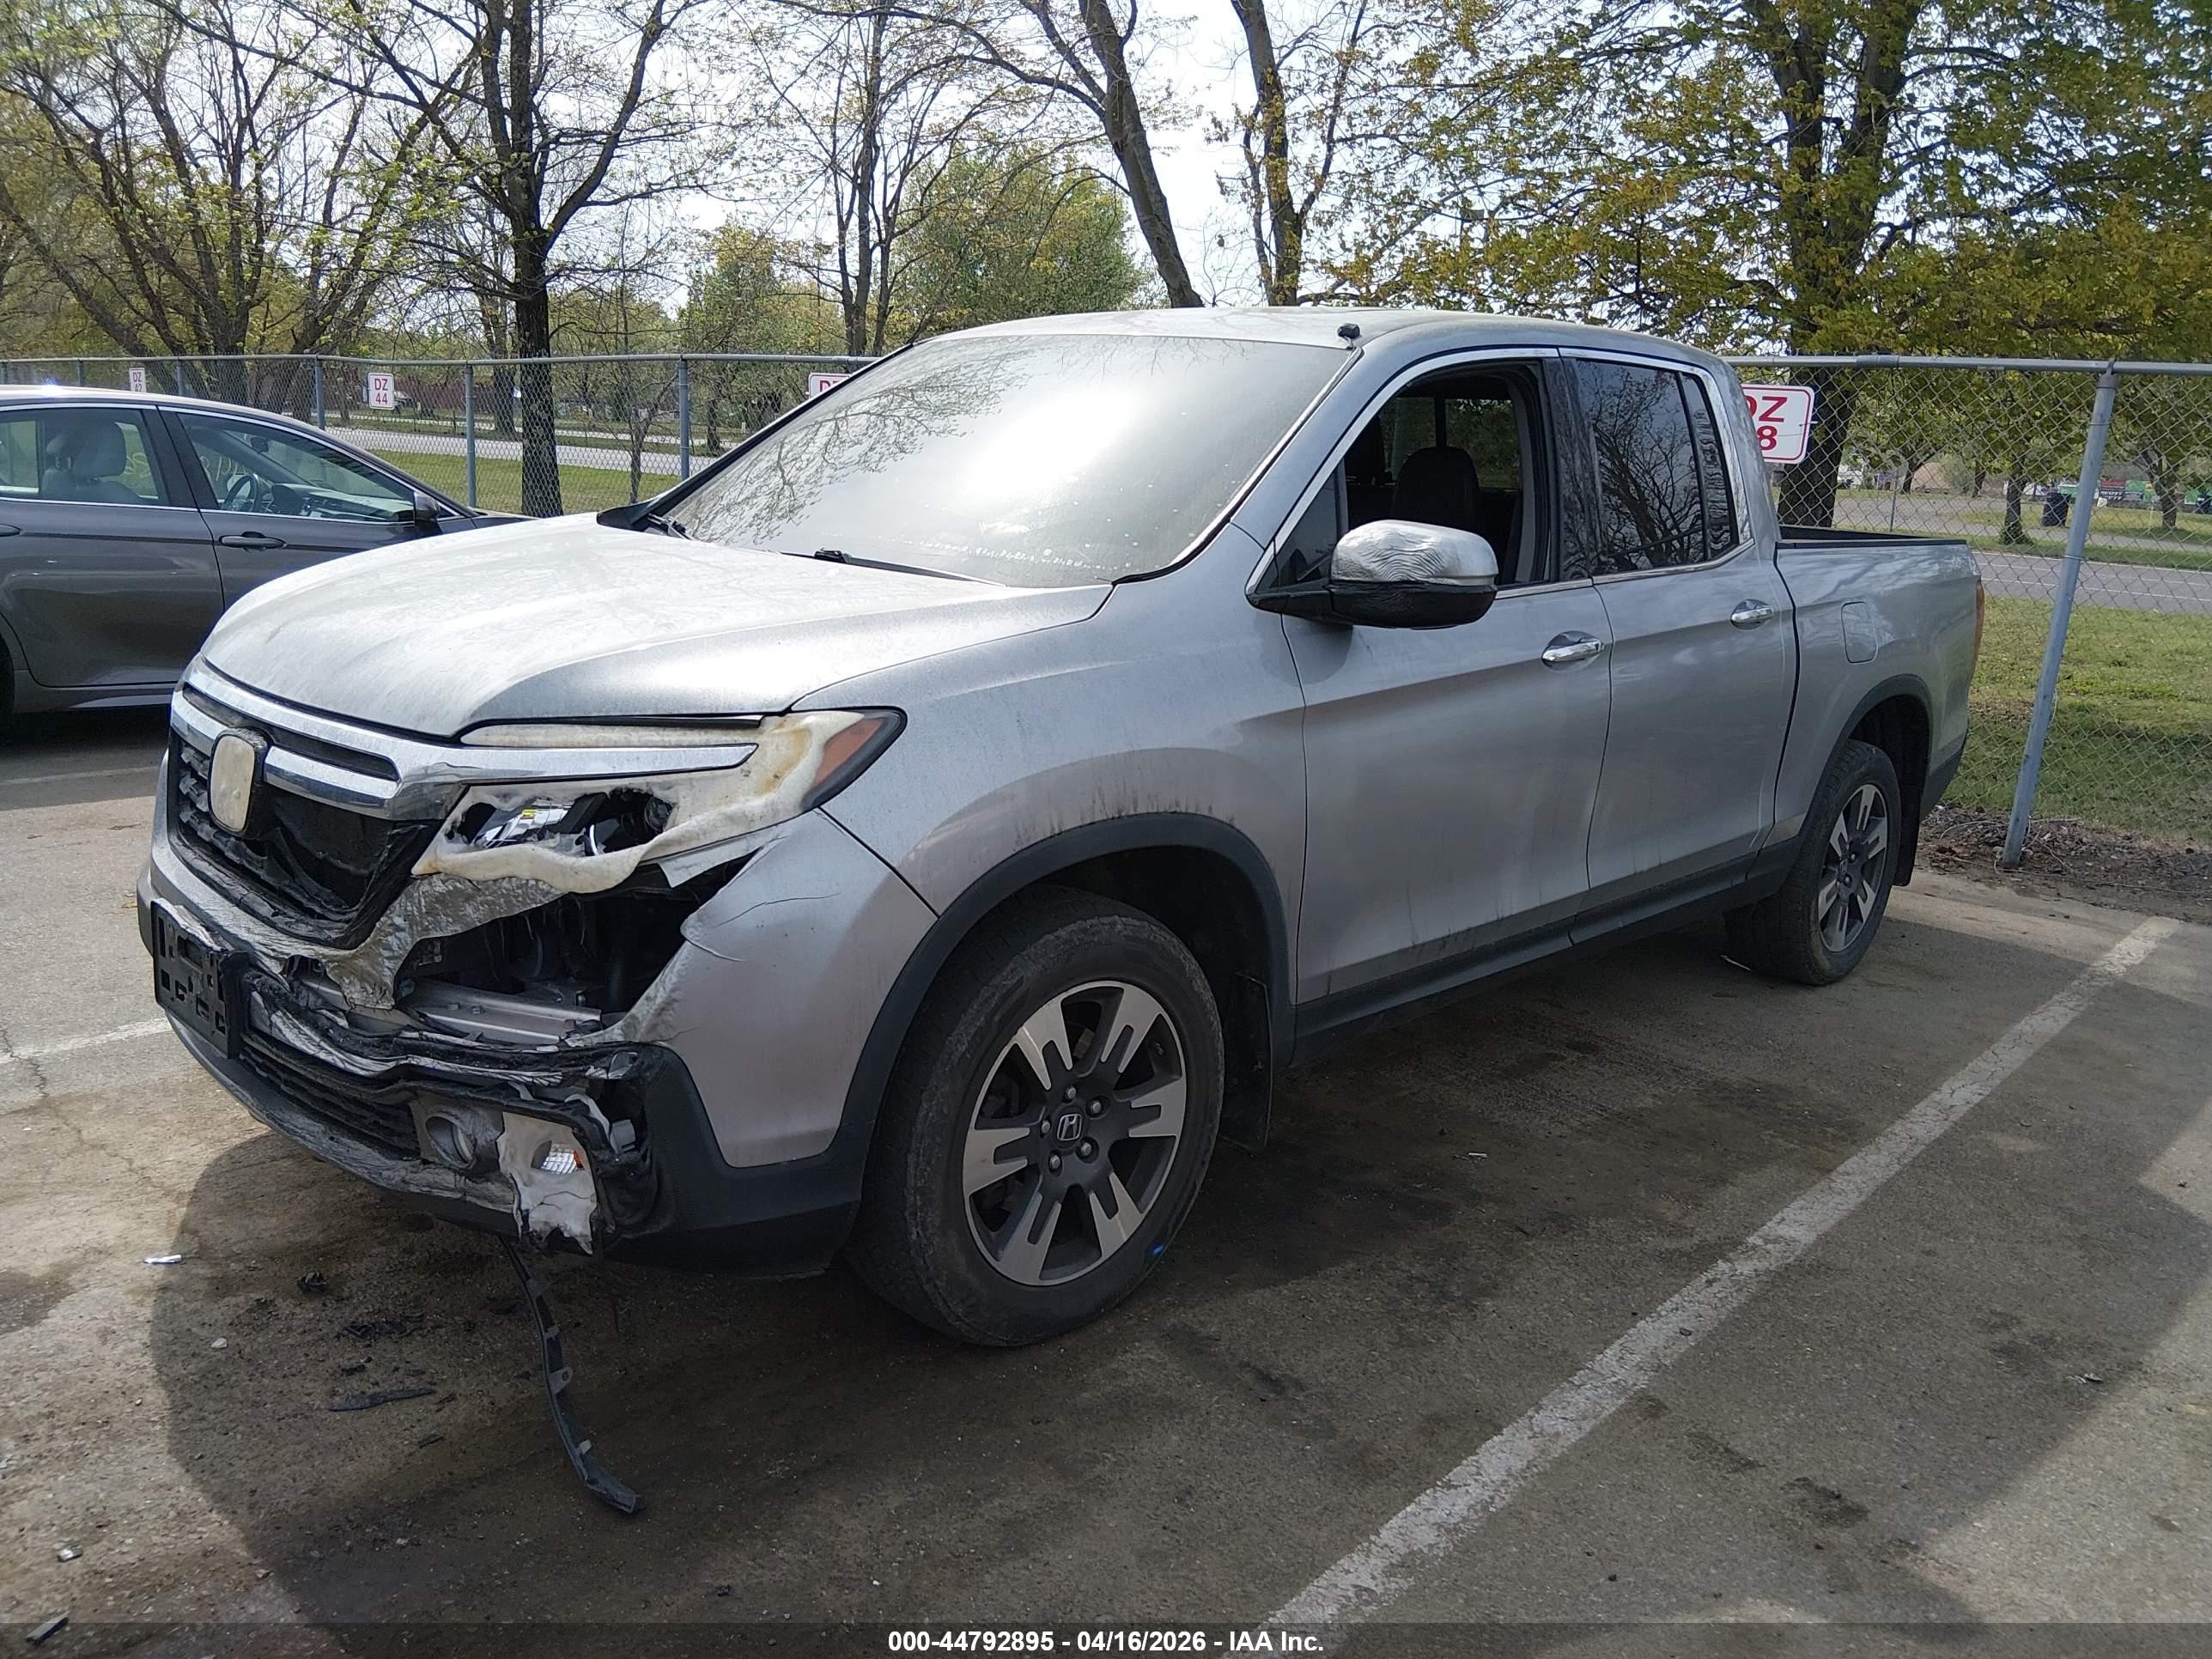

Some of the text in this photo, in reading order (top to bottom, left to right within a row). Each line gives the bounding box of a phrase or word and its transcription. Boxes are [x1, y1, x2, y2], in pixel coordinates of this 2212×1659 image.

[133, 372, 143, 383] DZ
[374, 378, 389, 391] DZ
[375, 392, 388, 404] 44
[1756, 425, 1778, 451] 8
